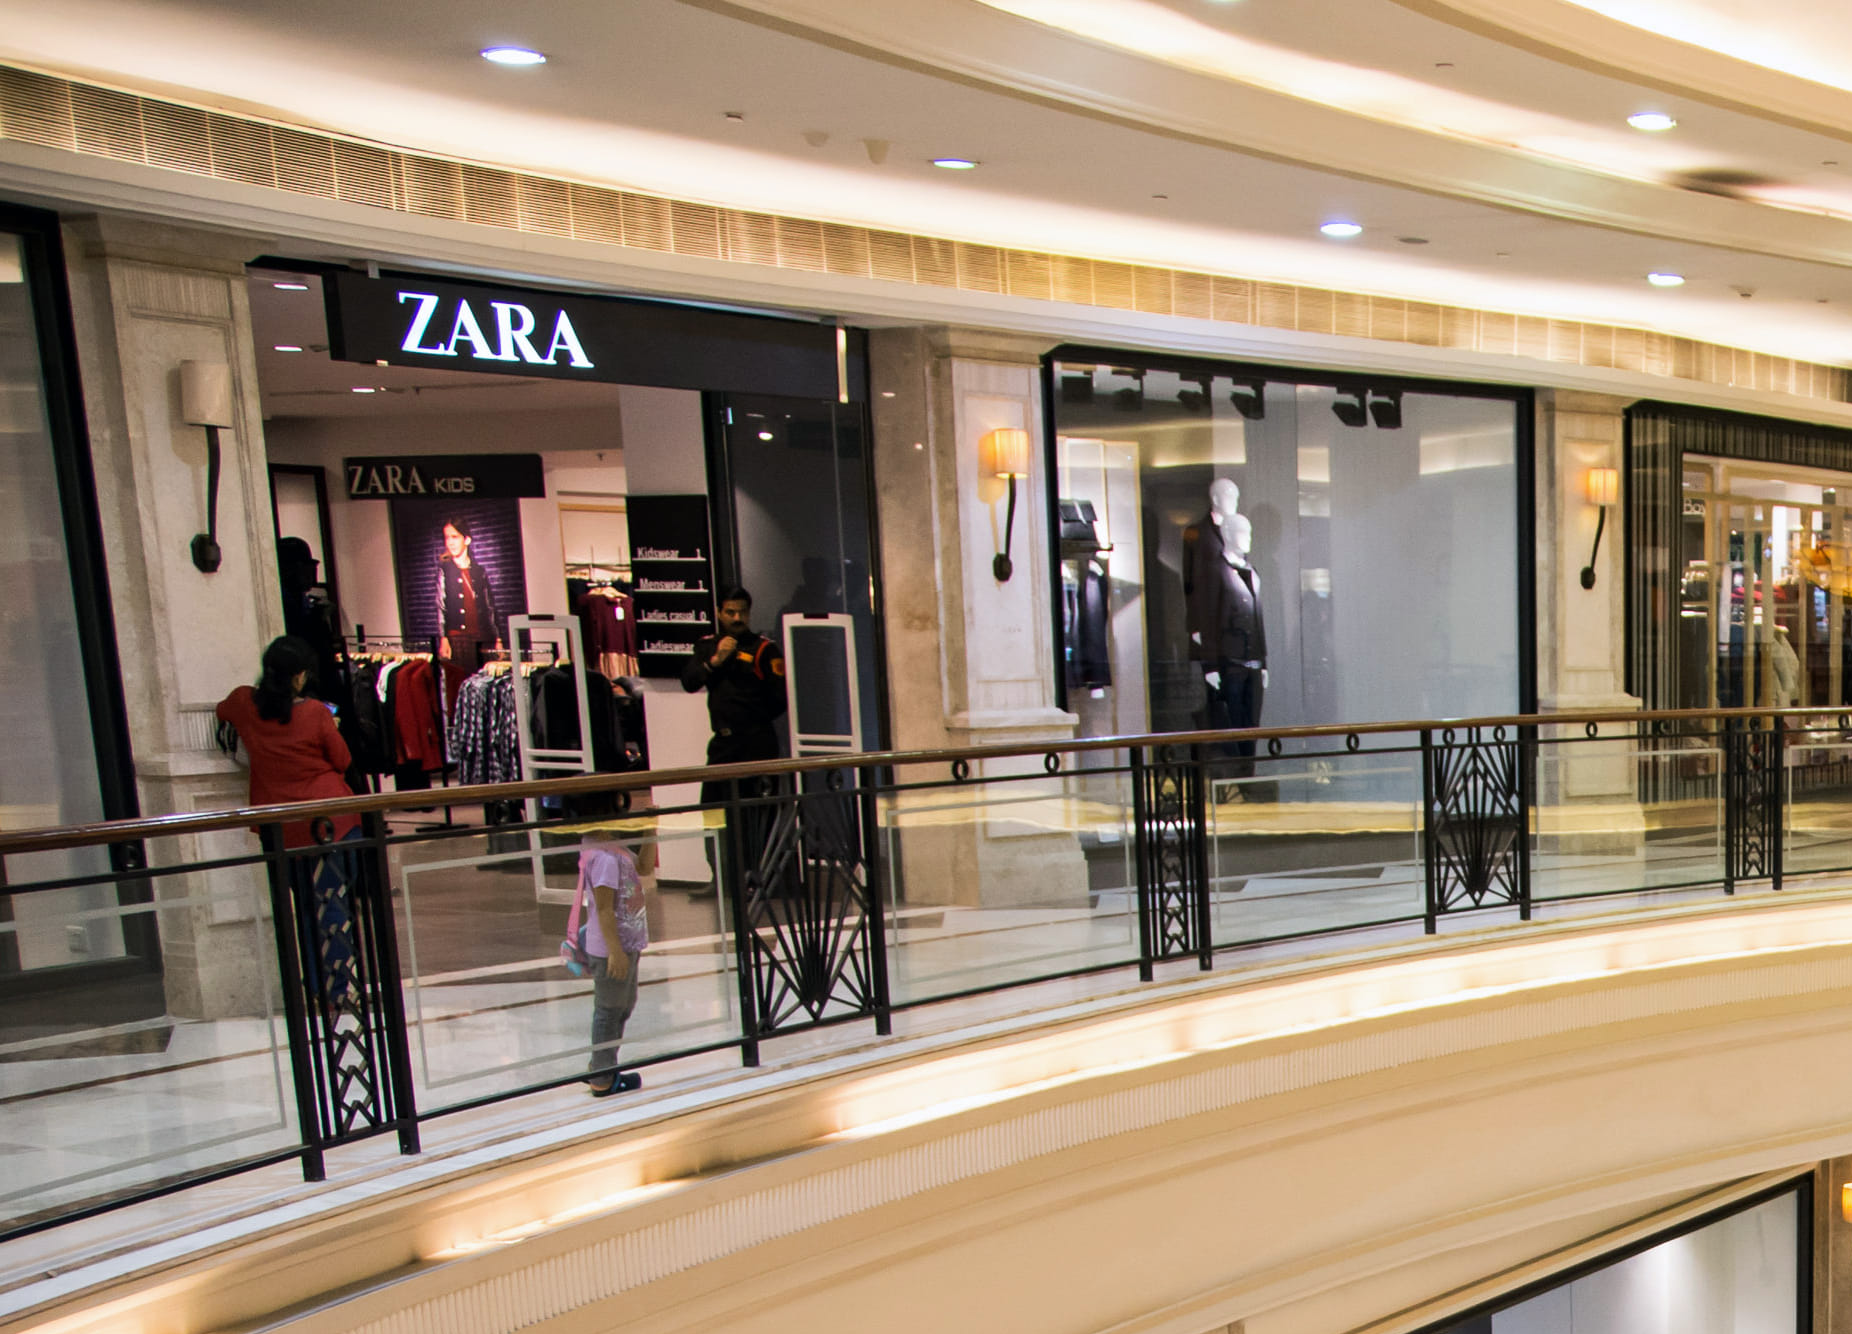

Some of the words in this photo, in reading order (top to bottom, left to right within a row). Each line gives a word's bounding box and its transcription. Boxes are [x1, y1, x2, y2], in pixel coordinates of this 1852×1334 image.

[397, 291, 595, 369] ZARA
[348, 464, 427, 495] ZARA
[434, 476, 475, 494] KIDS
[636, 546, 680, 559] Kidswear
[639, 577, 686, 590] Menswear
